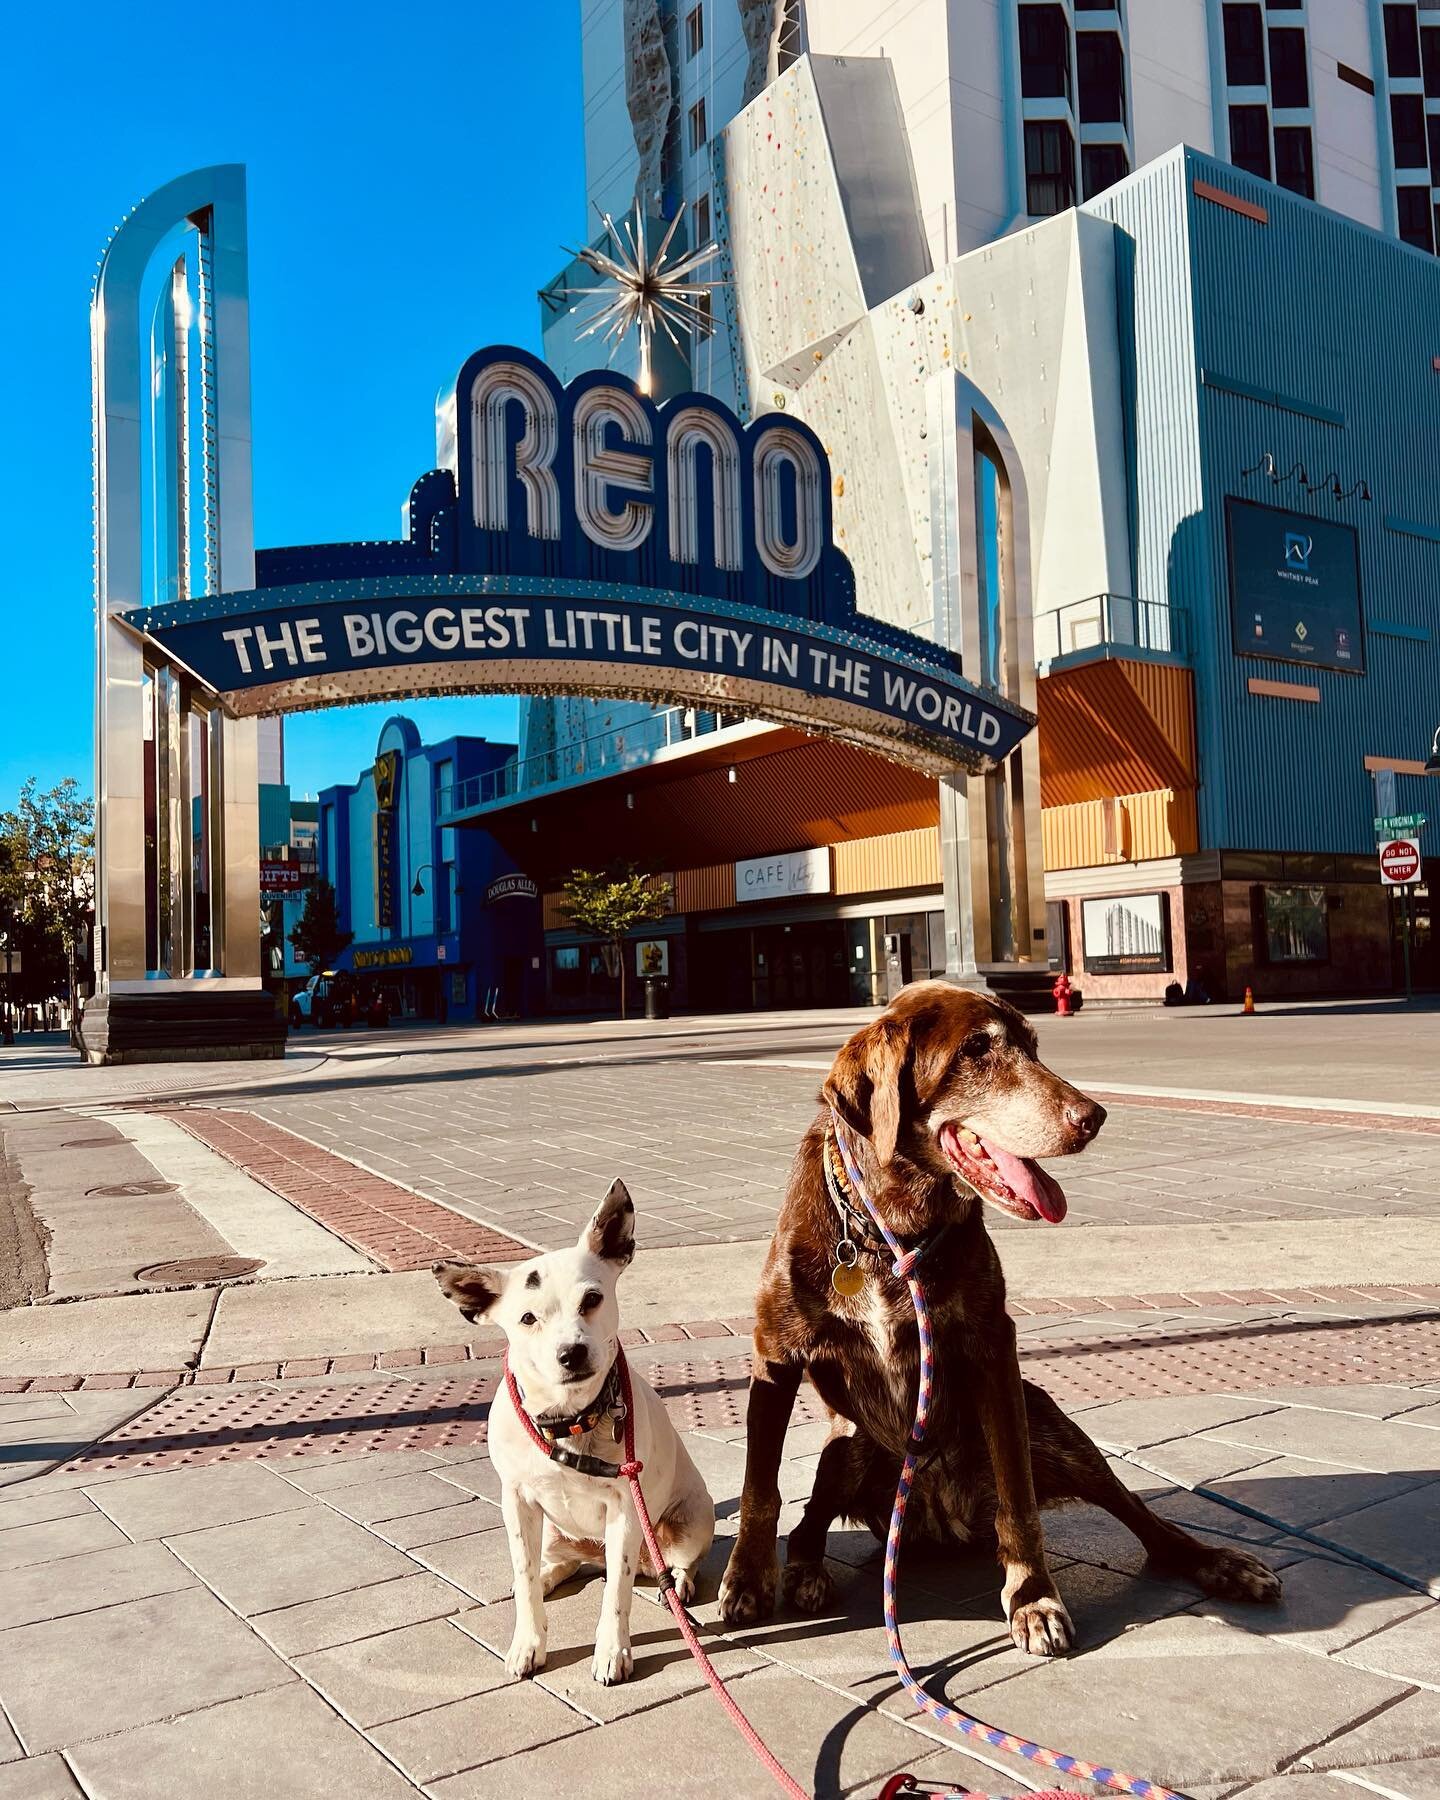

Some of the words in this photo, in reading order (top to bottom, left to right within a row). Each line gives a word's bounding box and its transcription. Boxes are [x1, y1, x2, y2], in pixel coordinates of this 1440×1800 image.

[1277, 569, 1304, 582] WHITNEY
[1305, 575, 1318, 585] PEAK
[222, 618, 328, 673] THE
[343, 607, 530, 657] BIGGEST
[545, 609, 662, 655] LITTLE
[673, 621, 753, 667] CITY
[762, 636, 799, 678] IN
[809, 649, 871, 698] THE
[883, 671, 1000, 747] WORLD
[1389, 816, 1414, 828] VIRGINIA
[1385, 849, 1396, 858] DO
[1399, 847, 1413, 856] NOT
[1389, 866, 1412, 875] ENTER
[261, 891, 301, 900] OUVENIRS
[487, 879, 516, 900] DOUGLAS
[517, 879, 537, 892] ALLEY
